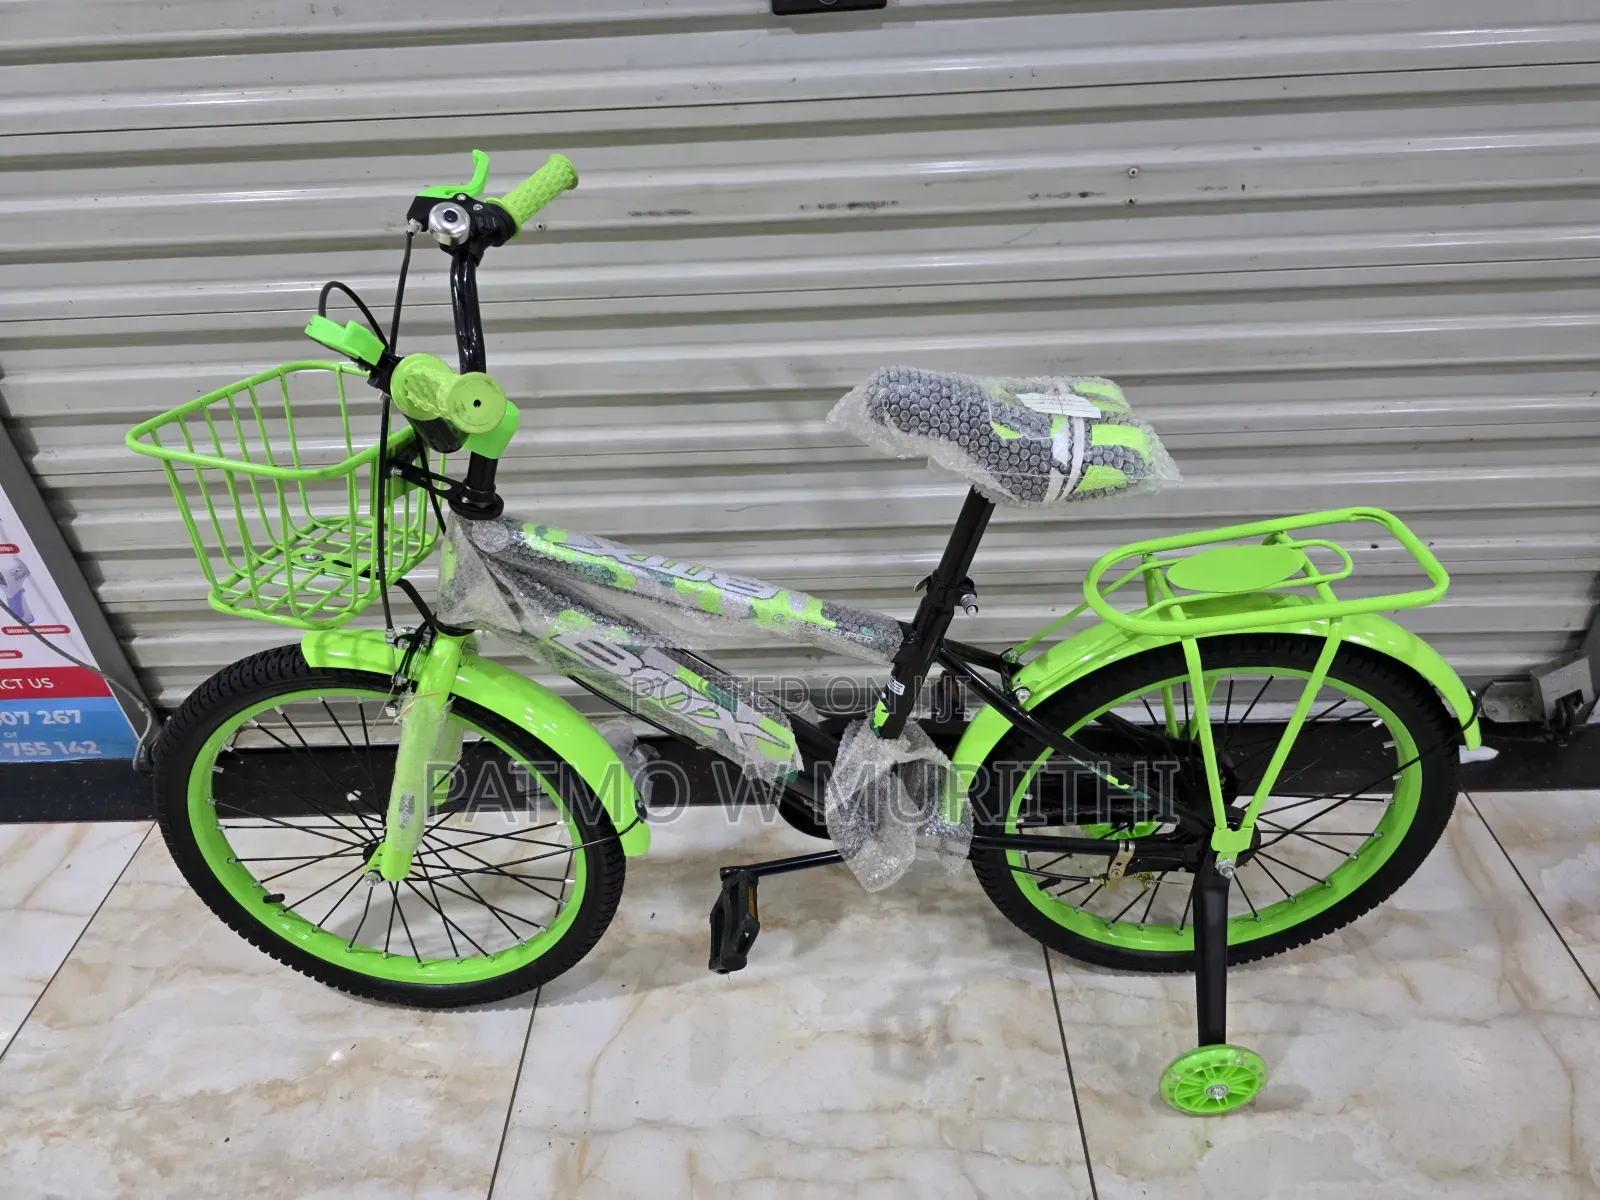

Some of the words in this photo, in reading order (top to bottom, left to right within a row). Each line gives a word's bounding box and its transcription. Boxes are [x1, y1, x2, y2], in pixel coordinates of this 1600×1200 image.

[829, 627, 874, 644] SUPER
[28, 677, 54, 689] US
[0, 711, 30, 725] 07
[36, 709, 81, 724] 267
[4, 741, 52, 756] 755
[54, 740, 102, 755] 142
